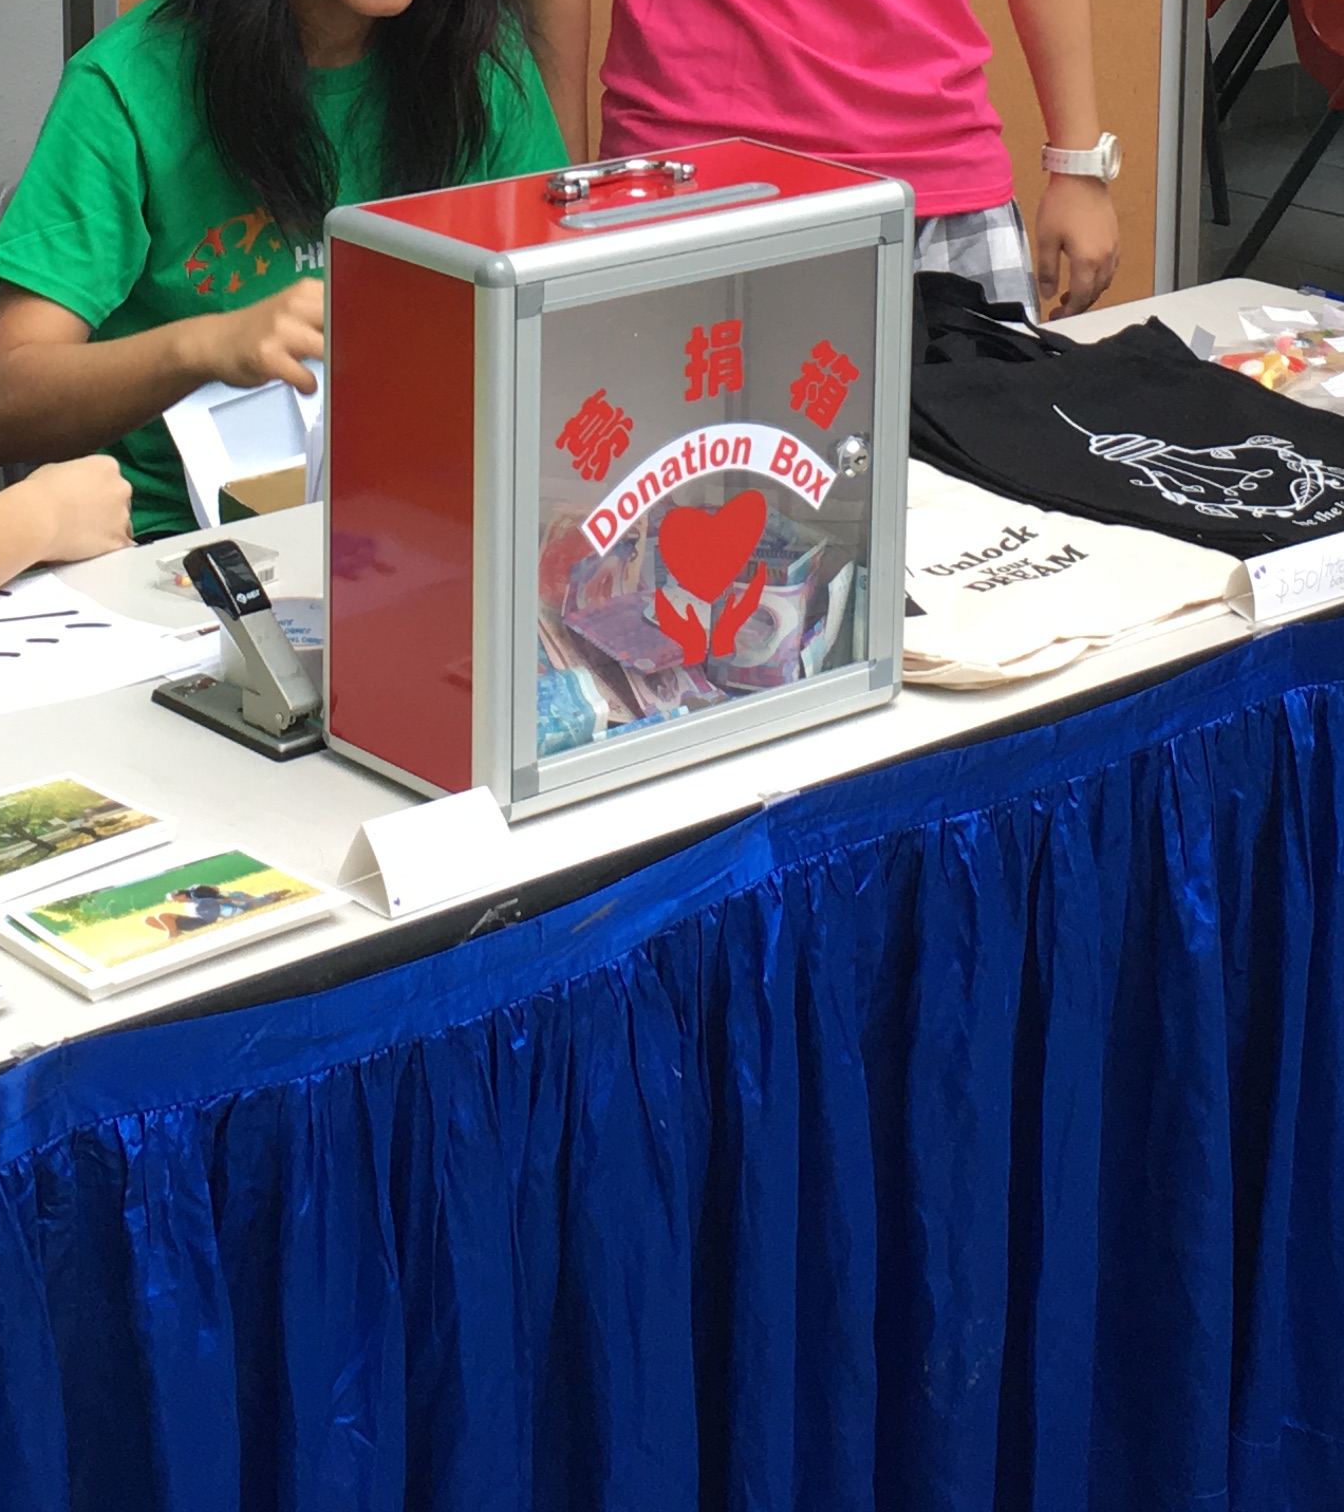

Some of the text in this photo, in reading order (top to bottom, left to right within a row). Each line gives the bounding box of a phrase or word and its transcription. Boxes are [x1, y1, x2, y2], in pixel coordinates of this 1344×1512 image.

[587, 432, 836, 549] Donation Box
[921, 525, 1040, 578] Unlock
[963, 543, 1090, 593] DREAM
[978, 557, 1033, 578] Your
